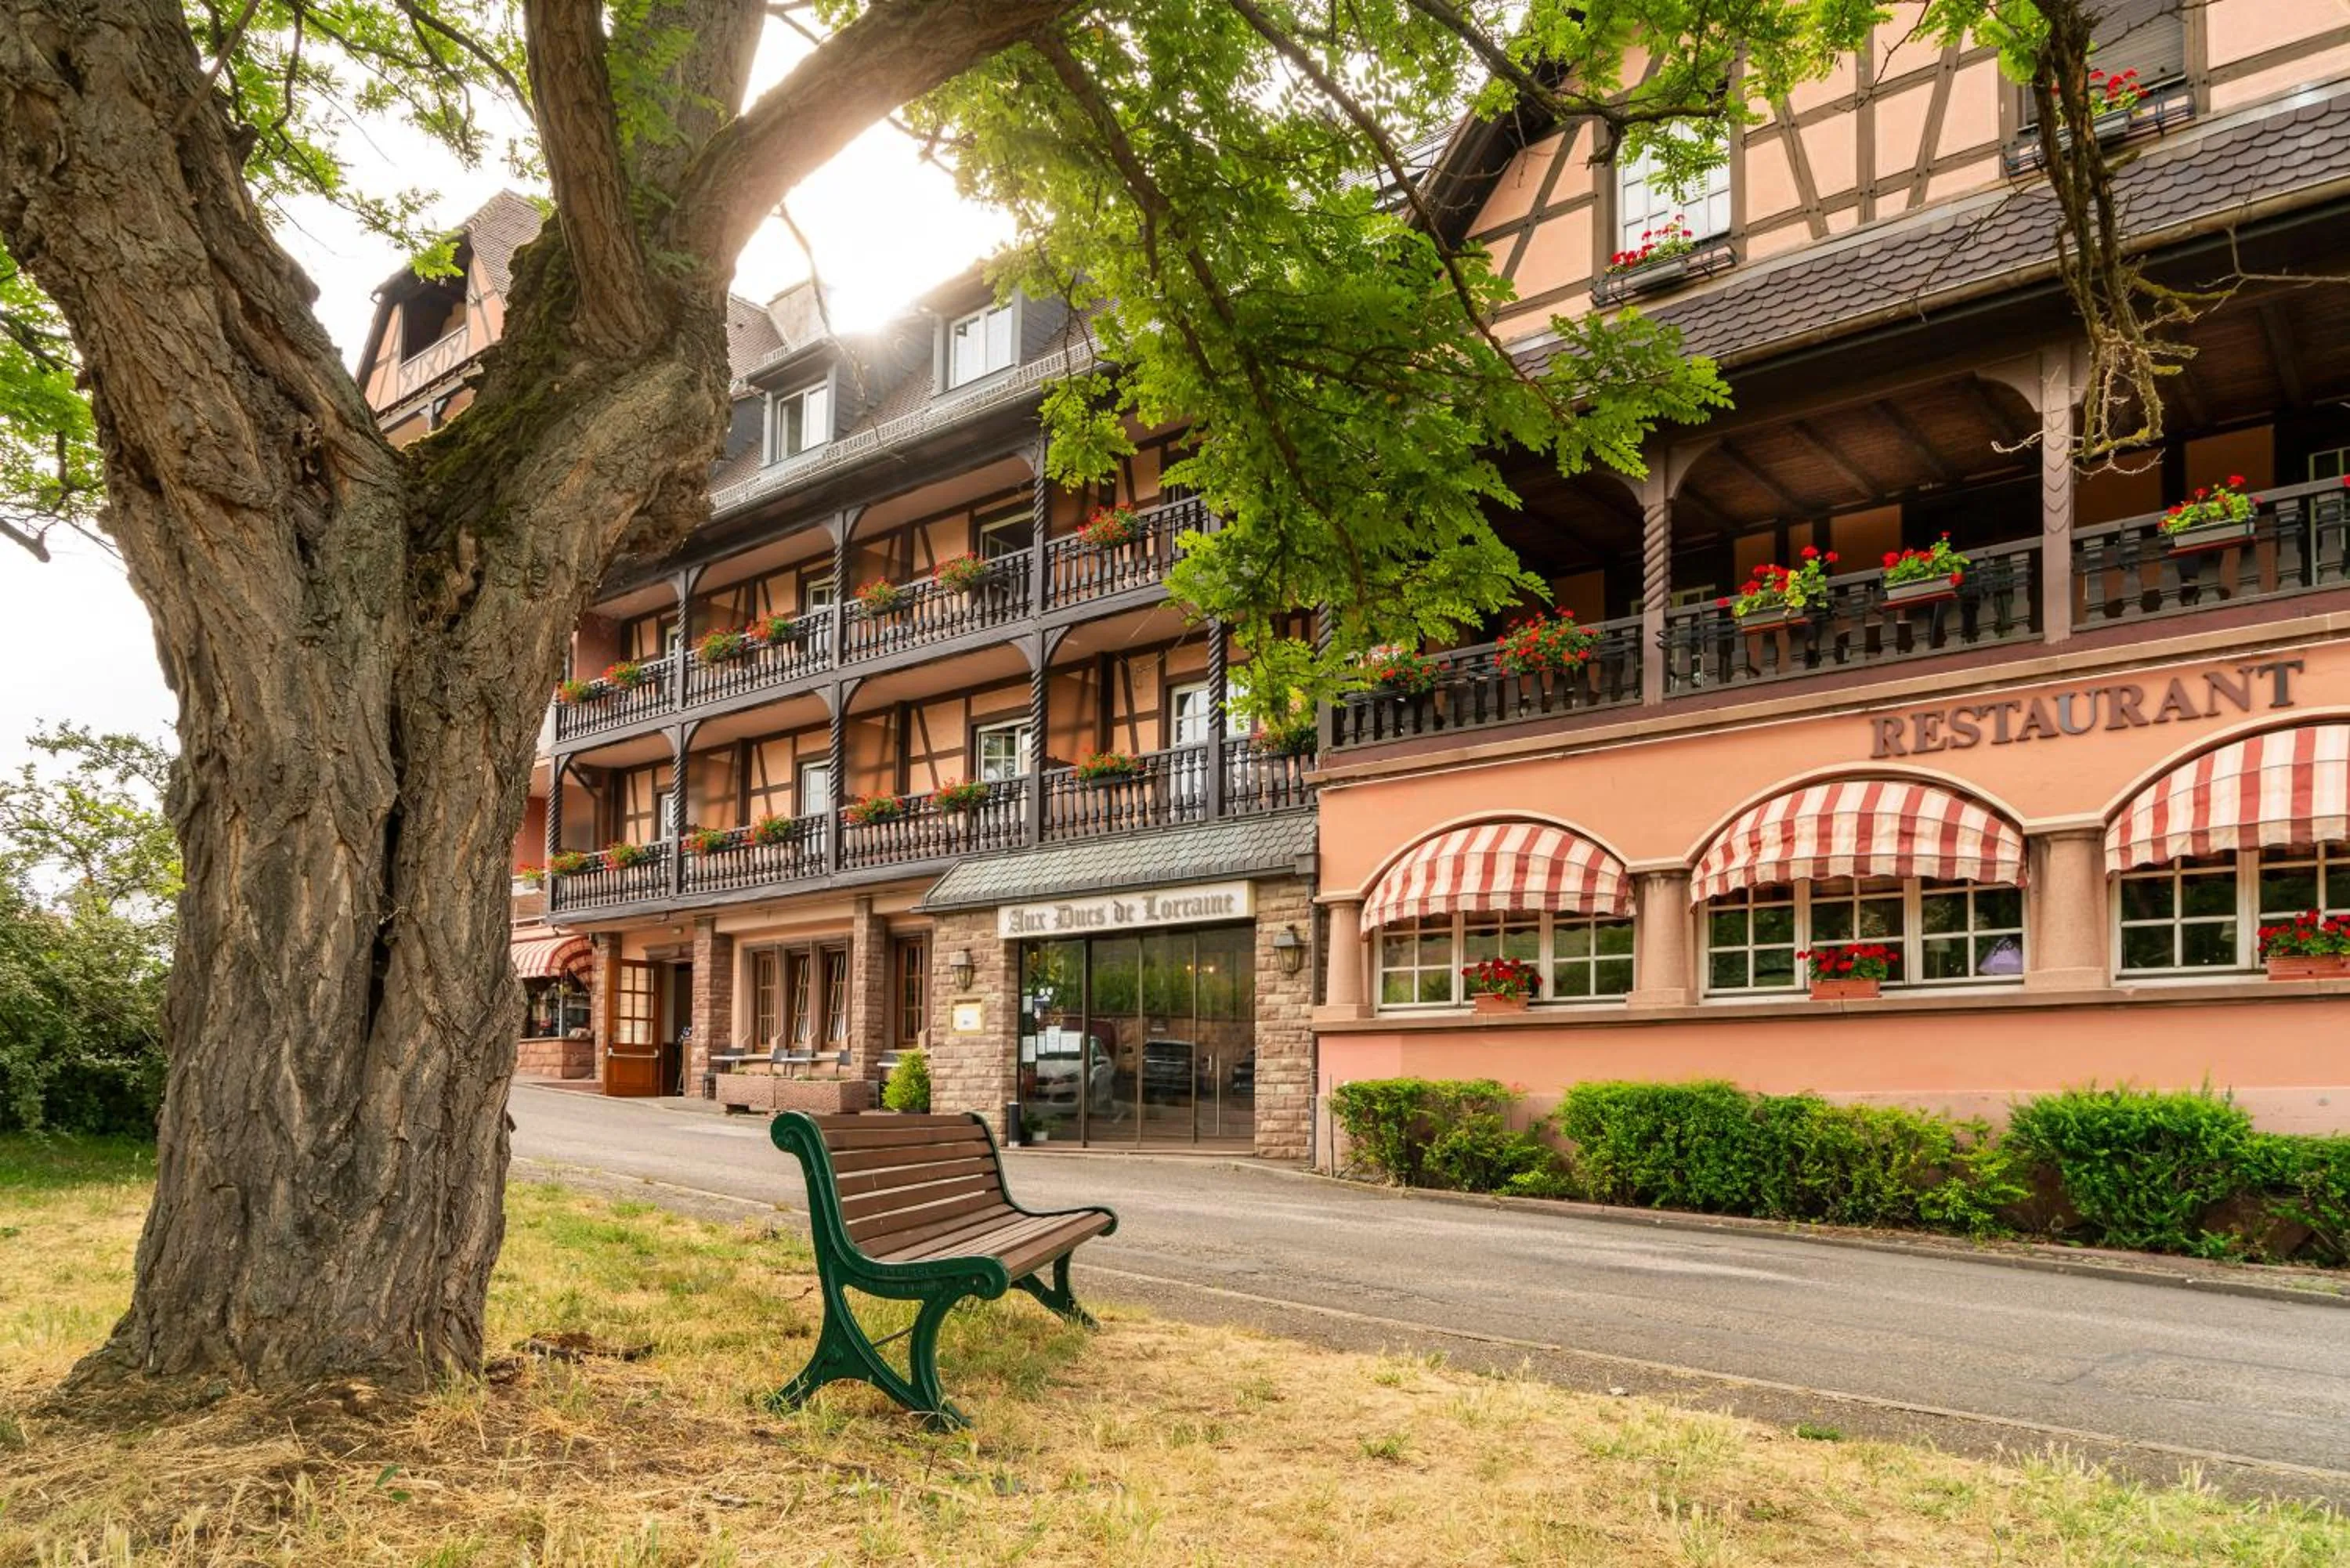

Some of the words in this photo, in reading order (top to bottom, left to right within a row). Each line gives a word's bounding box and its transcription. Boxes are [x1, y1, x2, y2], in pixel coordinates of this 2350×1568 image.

[1869, 660, 2305, 759] RESTAURANT
[1007, 909, 1047, 934] Aux
[1054, 903, 1106, 930] Ducs
[1113, 900, 1135, 923] de
[1141, 893, 1235, 921] Lorraine
